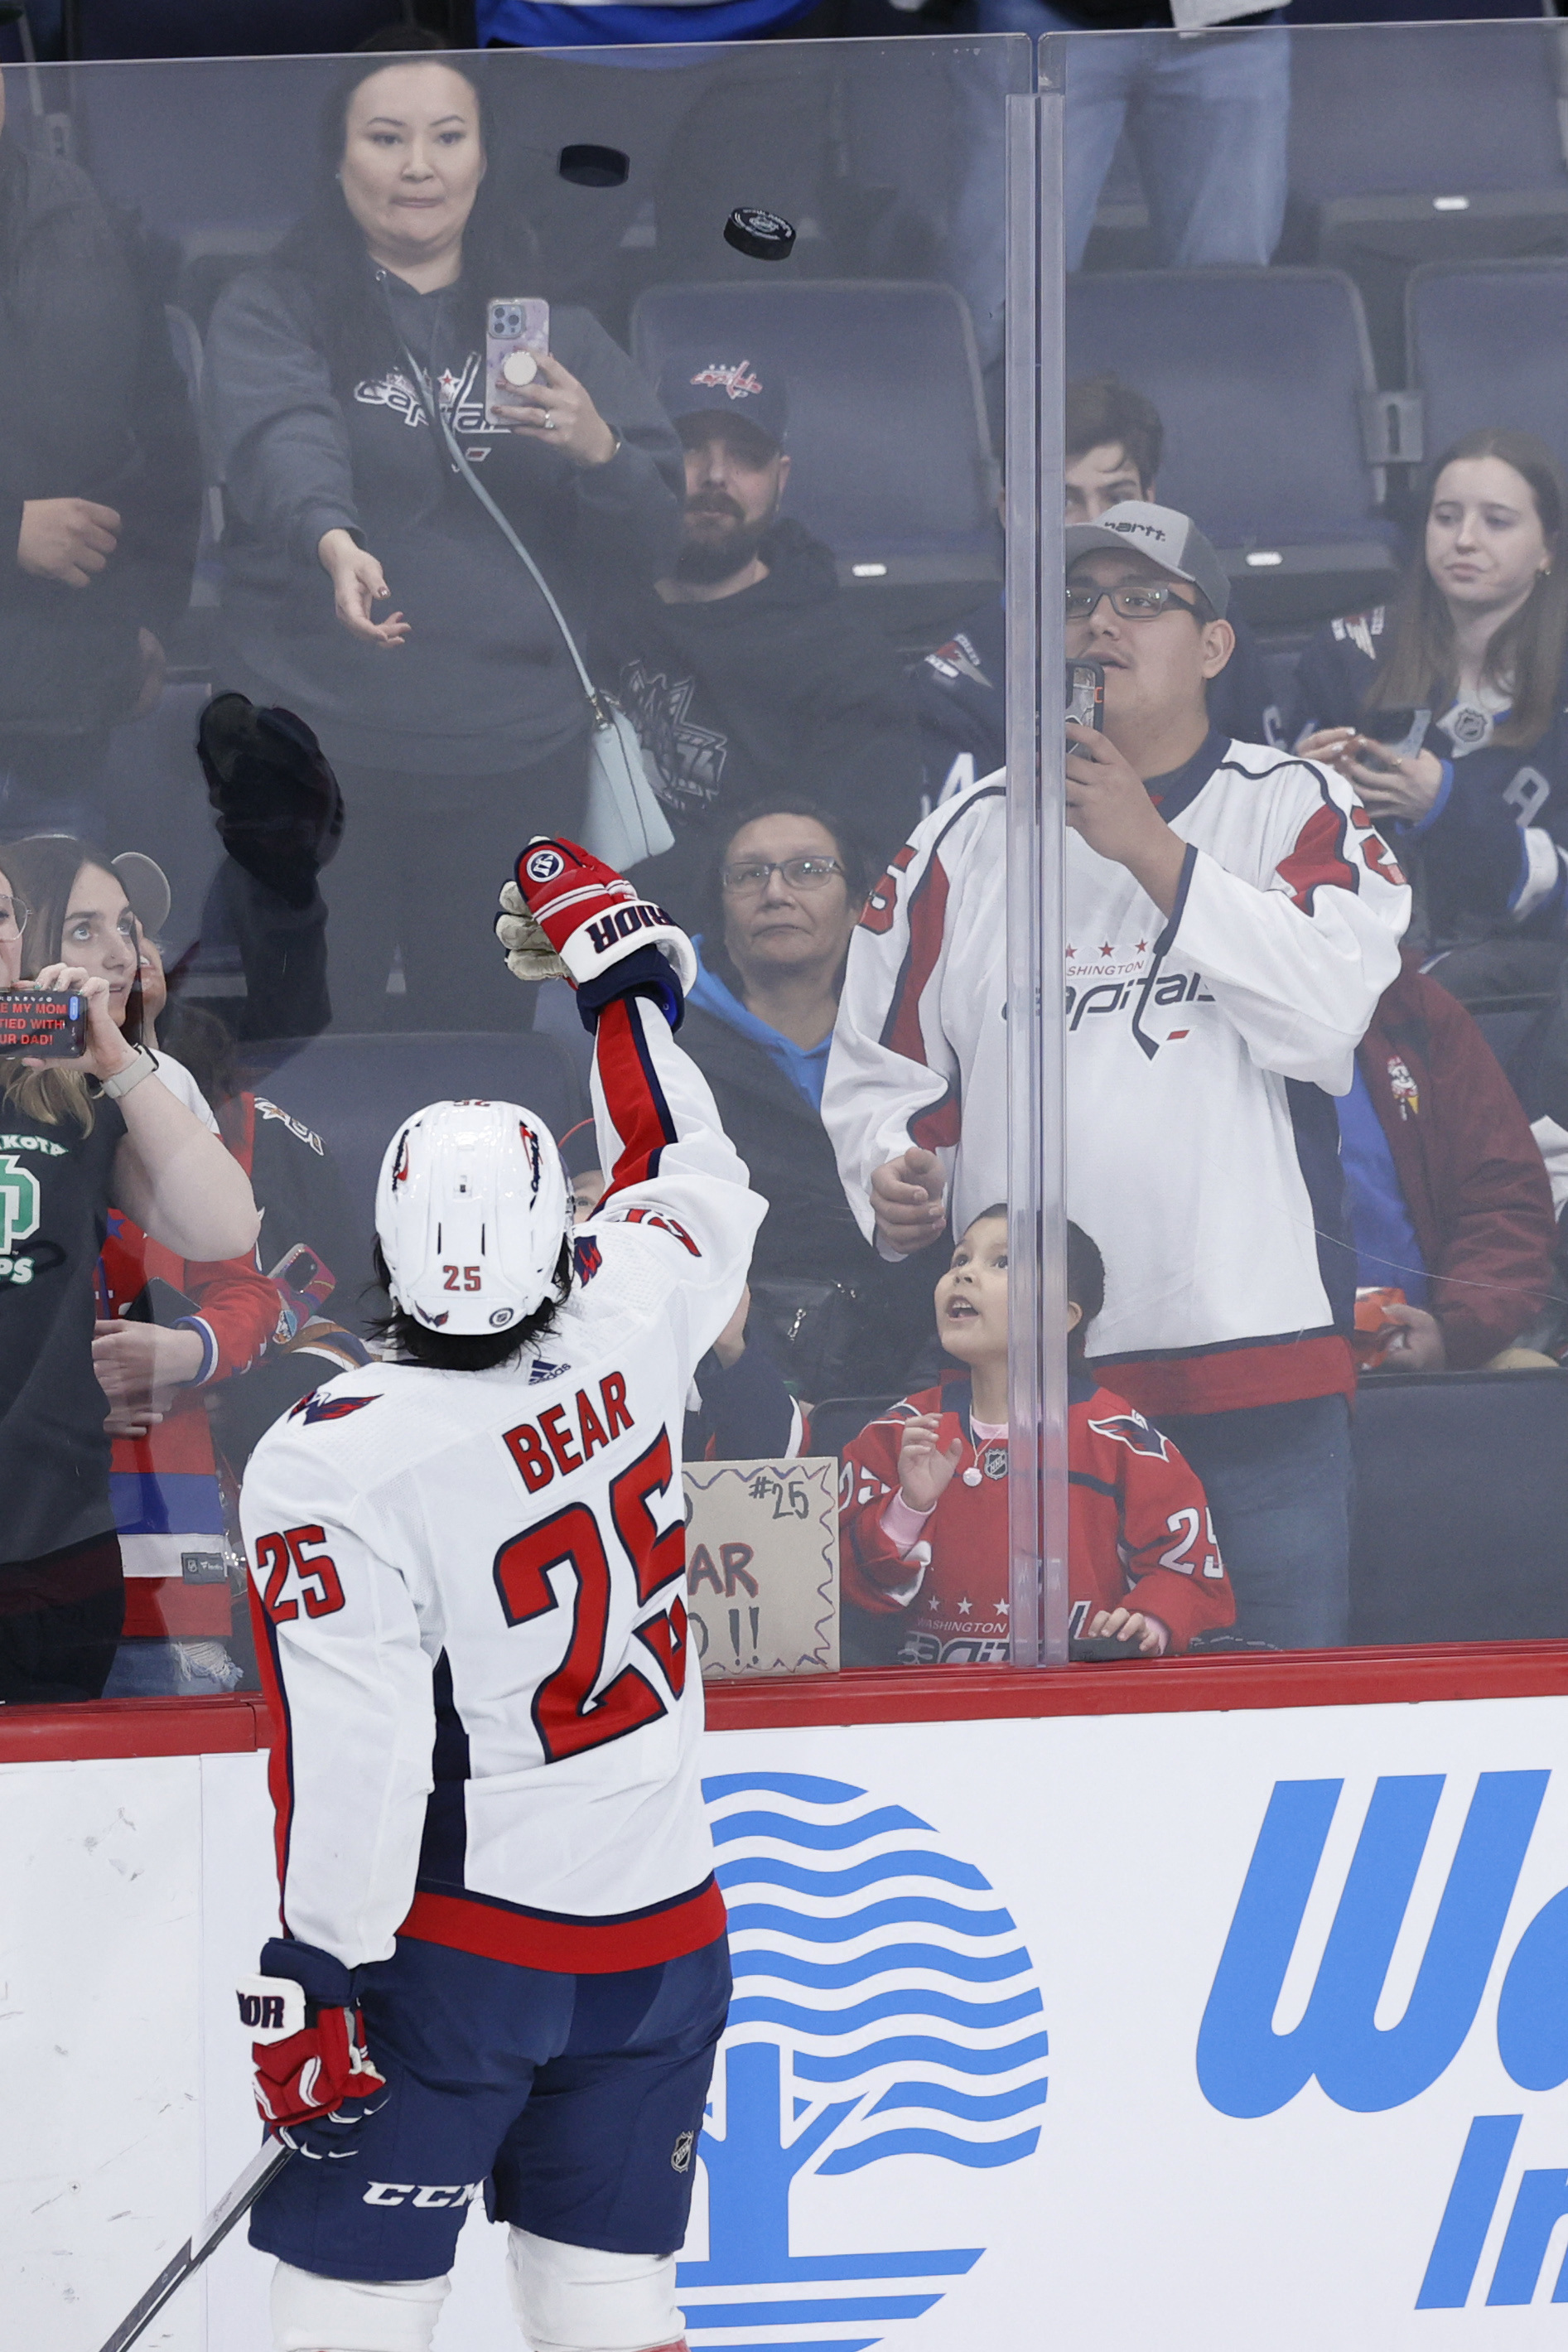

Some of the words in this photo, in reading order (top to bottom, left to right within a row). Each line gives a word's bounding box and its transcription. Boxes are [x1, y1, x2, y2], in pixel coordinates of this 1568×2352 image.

[1066, 960, 1144, 977] SHINGTON
[12, 1003, 32, 1013] MY
[36, 1003, 67, 1015] MOM
[21, 1034, 52, 1046] DAD!
[443, 1265, 482, 1292] 25
[502, 1371, 634, 1495] BEAR
[749, 1476, 809, 1519] #25
[255, 1524, 346, 1625] 25
[687, 1543, 760, 1599] AR
[493, 1422, 687, 1765] 25
[917, 1616, 1007, 1634] WASHINGTON
